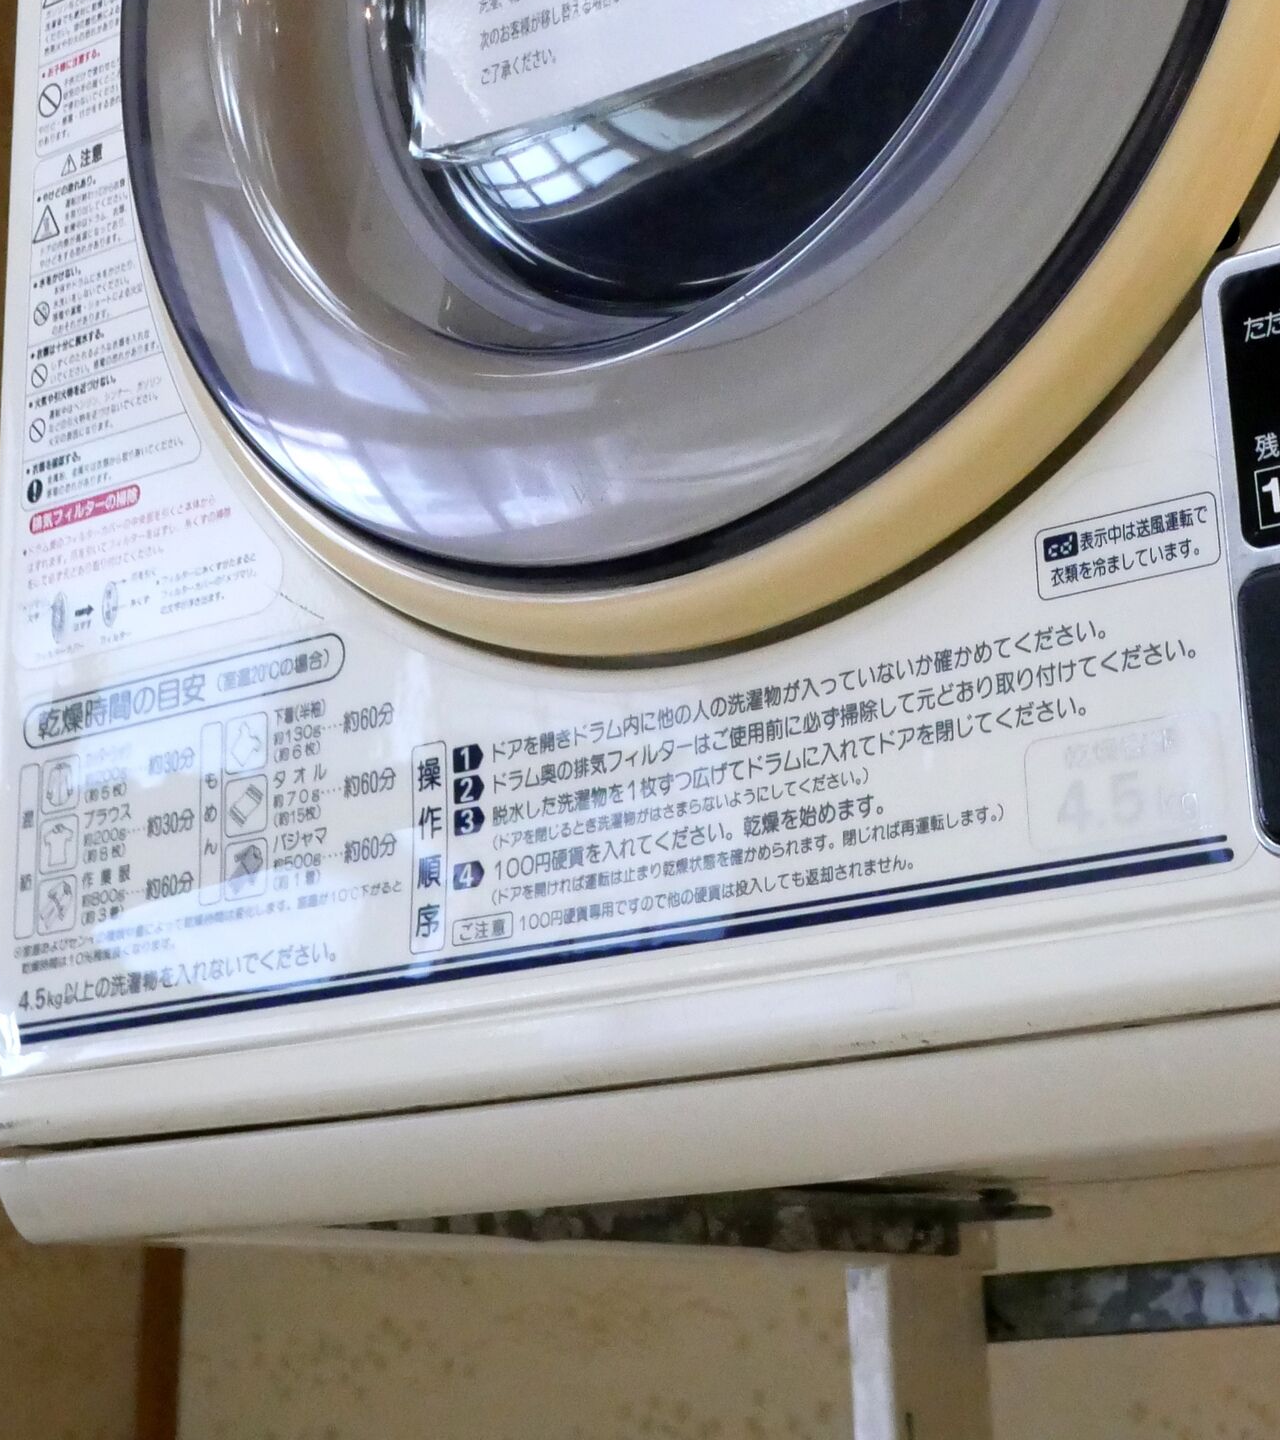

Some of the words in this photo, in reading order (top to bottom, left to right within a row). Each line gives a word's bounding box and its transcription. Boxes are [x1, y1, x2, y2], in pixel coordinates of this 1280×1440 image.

[480, 49, 557, 86] ご了承ください。
[1080, 505, 1208, 551] 表示中は送風運転で
[1051, 538, 1200, 587] 衣類を冷ましています。
[37, 672, 206, 741] 乾燥時間の目安
[343, 701, 395, 734] 約60分
[459, 747, 471, 769] 1
[492, 620, 1107, 762] ドアを開きドラム内に他の人の洗濯物が入っていないか確かめてください。
[458, 779, 475, 801] 2
[493, 639, 1197, 790] ドラム奥の排気フィルターはご使用前に必ず掃除して元どおり取り付けてください。
[344, 767, 396, 799] 約60分
[459, 811, 475, 833] 3
[493, 697, 1087, 825] 脱水した洗濯物を1枚ずつ広げてドラムに入れてドアを閉じてください。
[147, 808, 195, 838] 約30分
[416, 757, 442, 938] 操作順序
[459, 864, 475, 886] 4
[495, 794, 884, 881] 100円硬貨を入れてください。乾燥を始めます。
[344, 832, 397, 864] 約60分
[146, 871, 194, 900] 約60分
[458, 917, 506, 940] ご注意
[520, 853, 914, 932] 100円硬貨専用ですので他の硬貨は投入しても返却されません。
